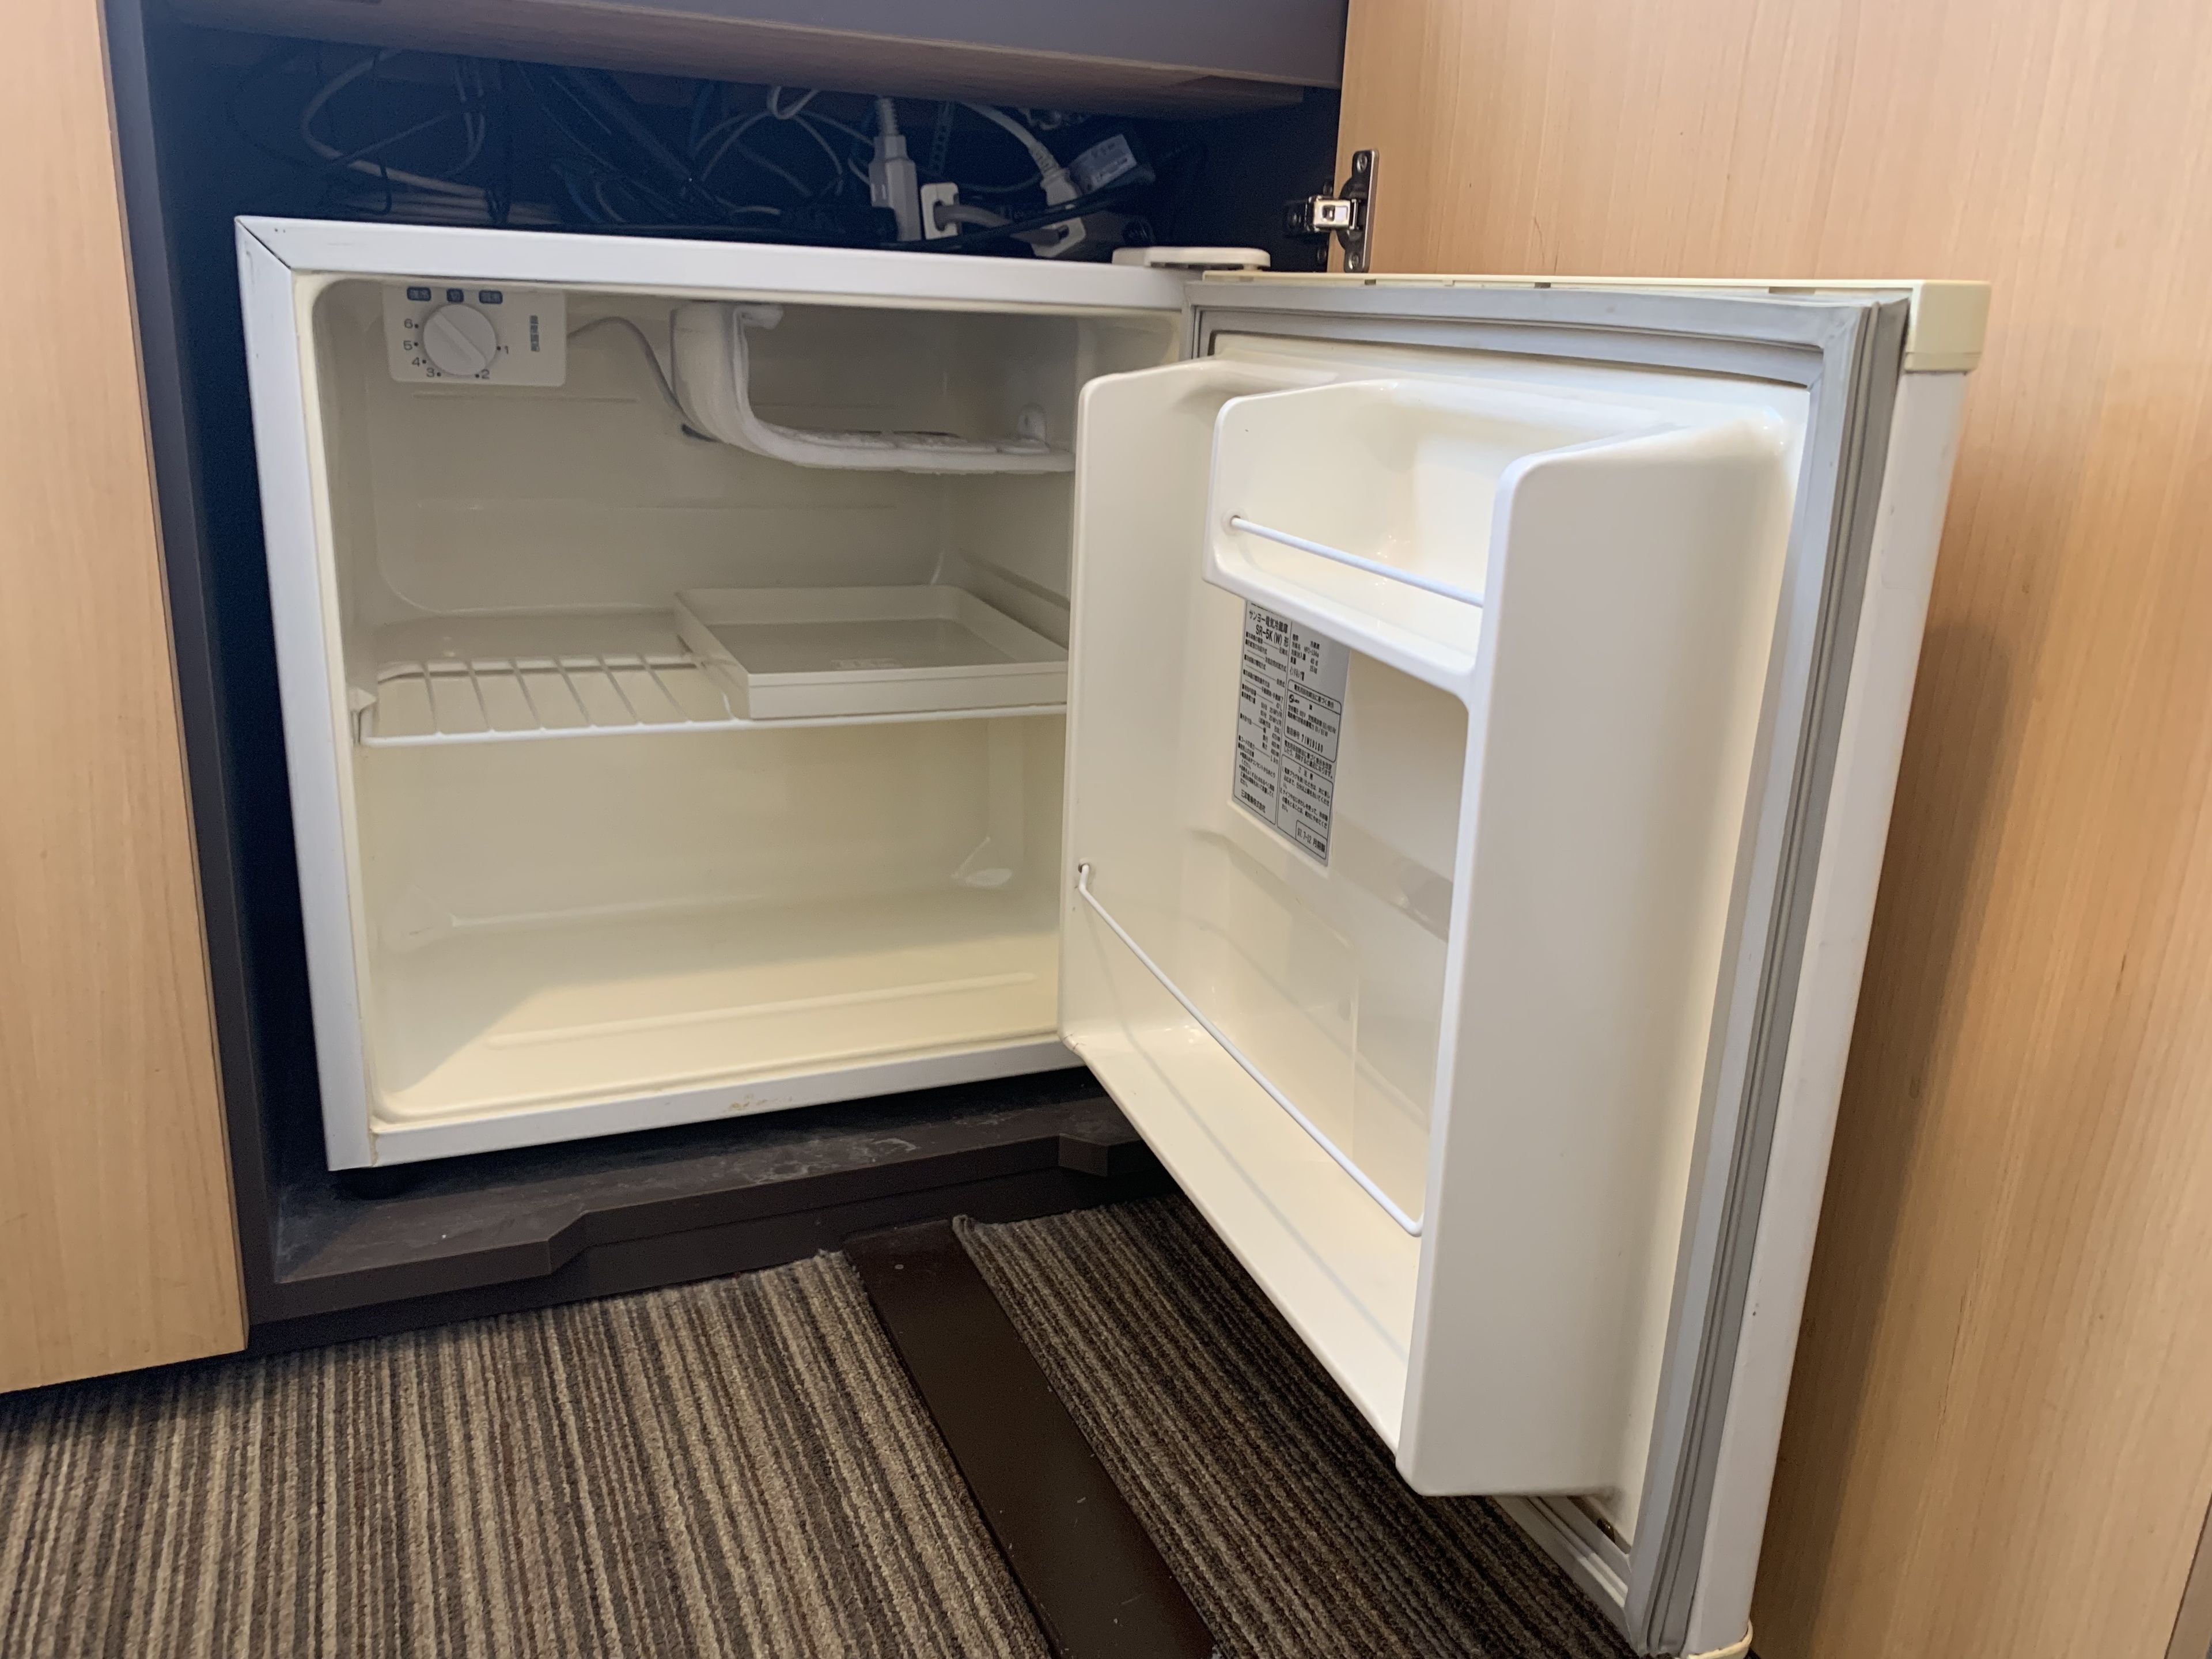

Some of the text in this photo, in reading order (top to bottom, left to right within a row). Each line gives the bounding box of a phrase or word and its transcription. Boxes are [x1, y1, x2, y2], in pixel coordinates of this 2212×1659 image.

[404, 318, 413, 329] 6
[403, 340, 412, 351] 5
[412, 357, 420, 367] 4
[426, 367, 434, 378] 3
[481, 369, 490, 379] 2
